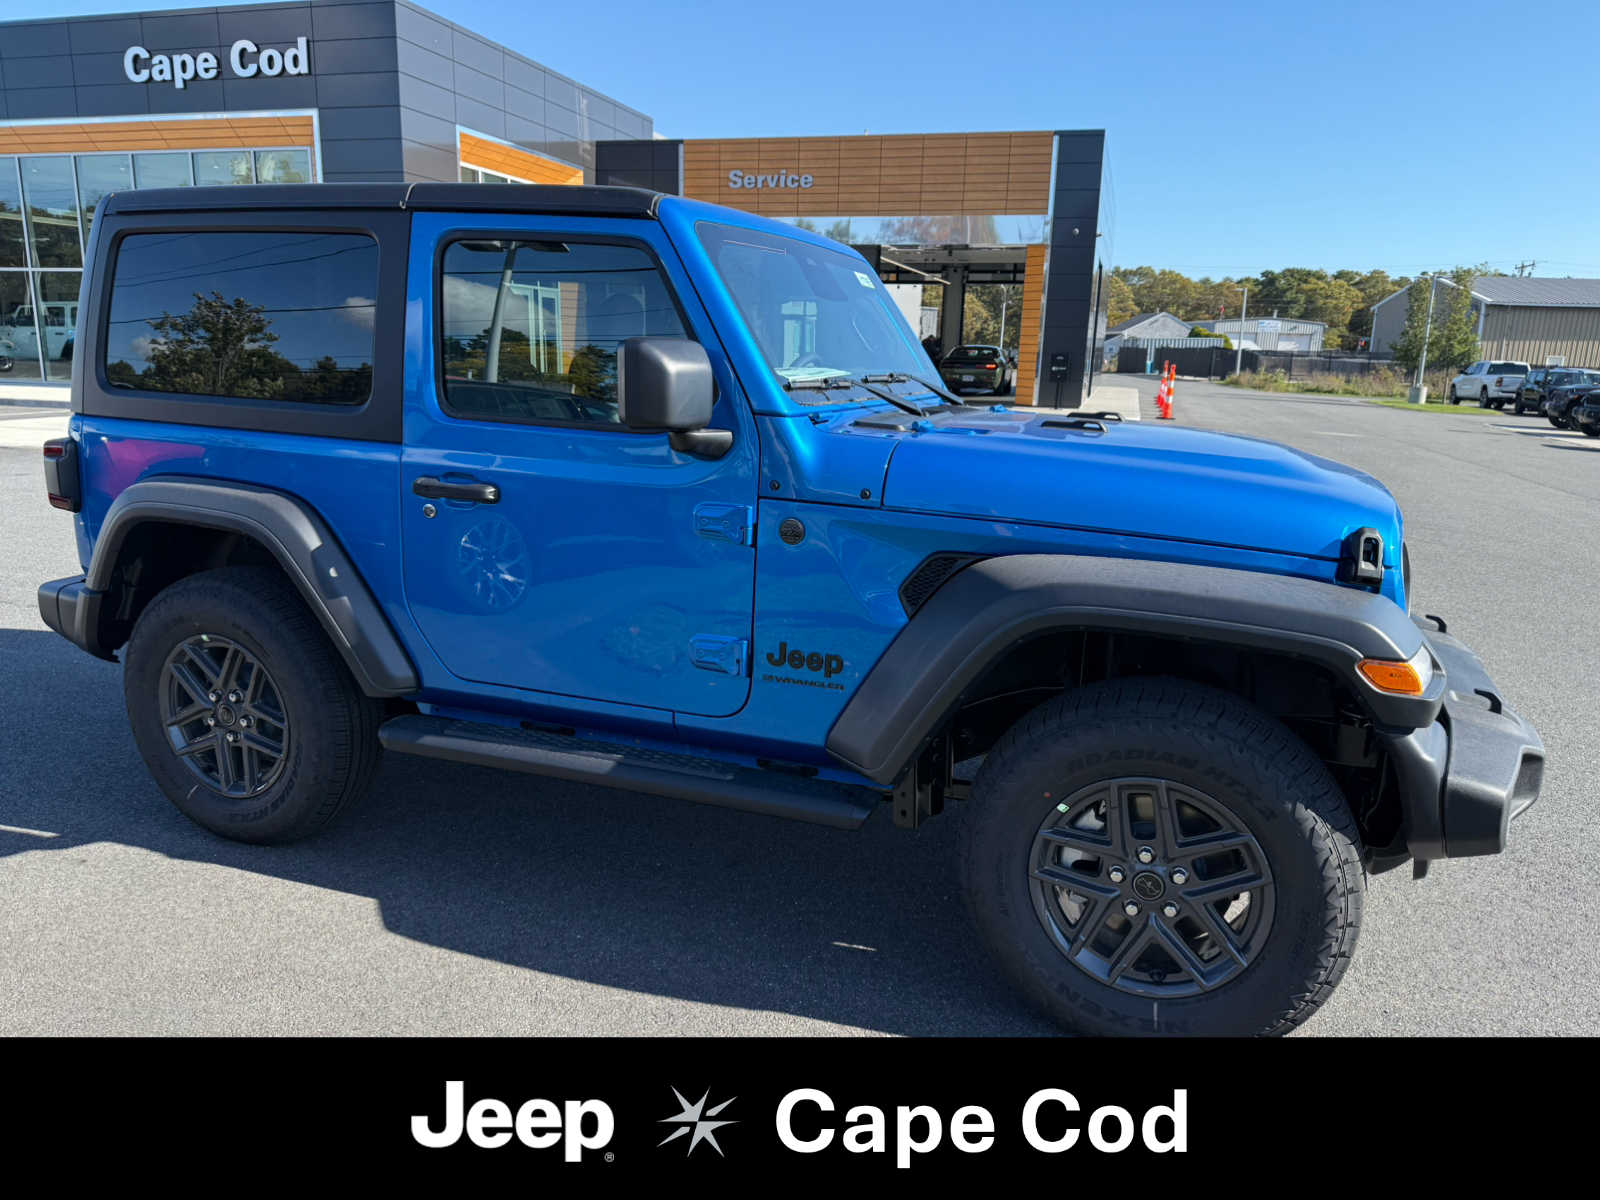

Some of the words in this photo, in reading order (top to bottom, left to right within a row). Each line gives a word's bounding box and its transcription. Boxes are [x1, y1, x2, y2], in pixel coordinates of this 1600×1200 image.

[123, 45, 219, 90] Cape
[229, 36, 310, 79] Cod
[728, 169, 814, 189] Service
[766, 641, 844, 679] Jeep
[774, 674, 845, 691] WRANGLER
